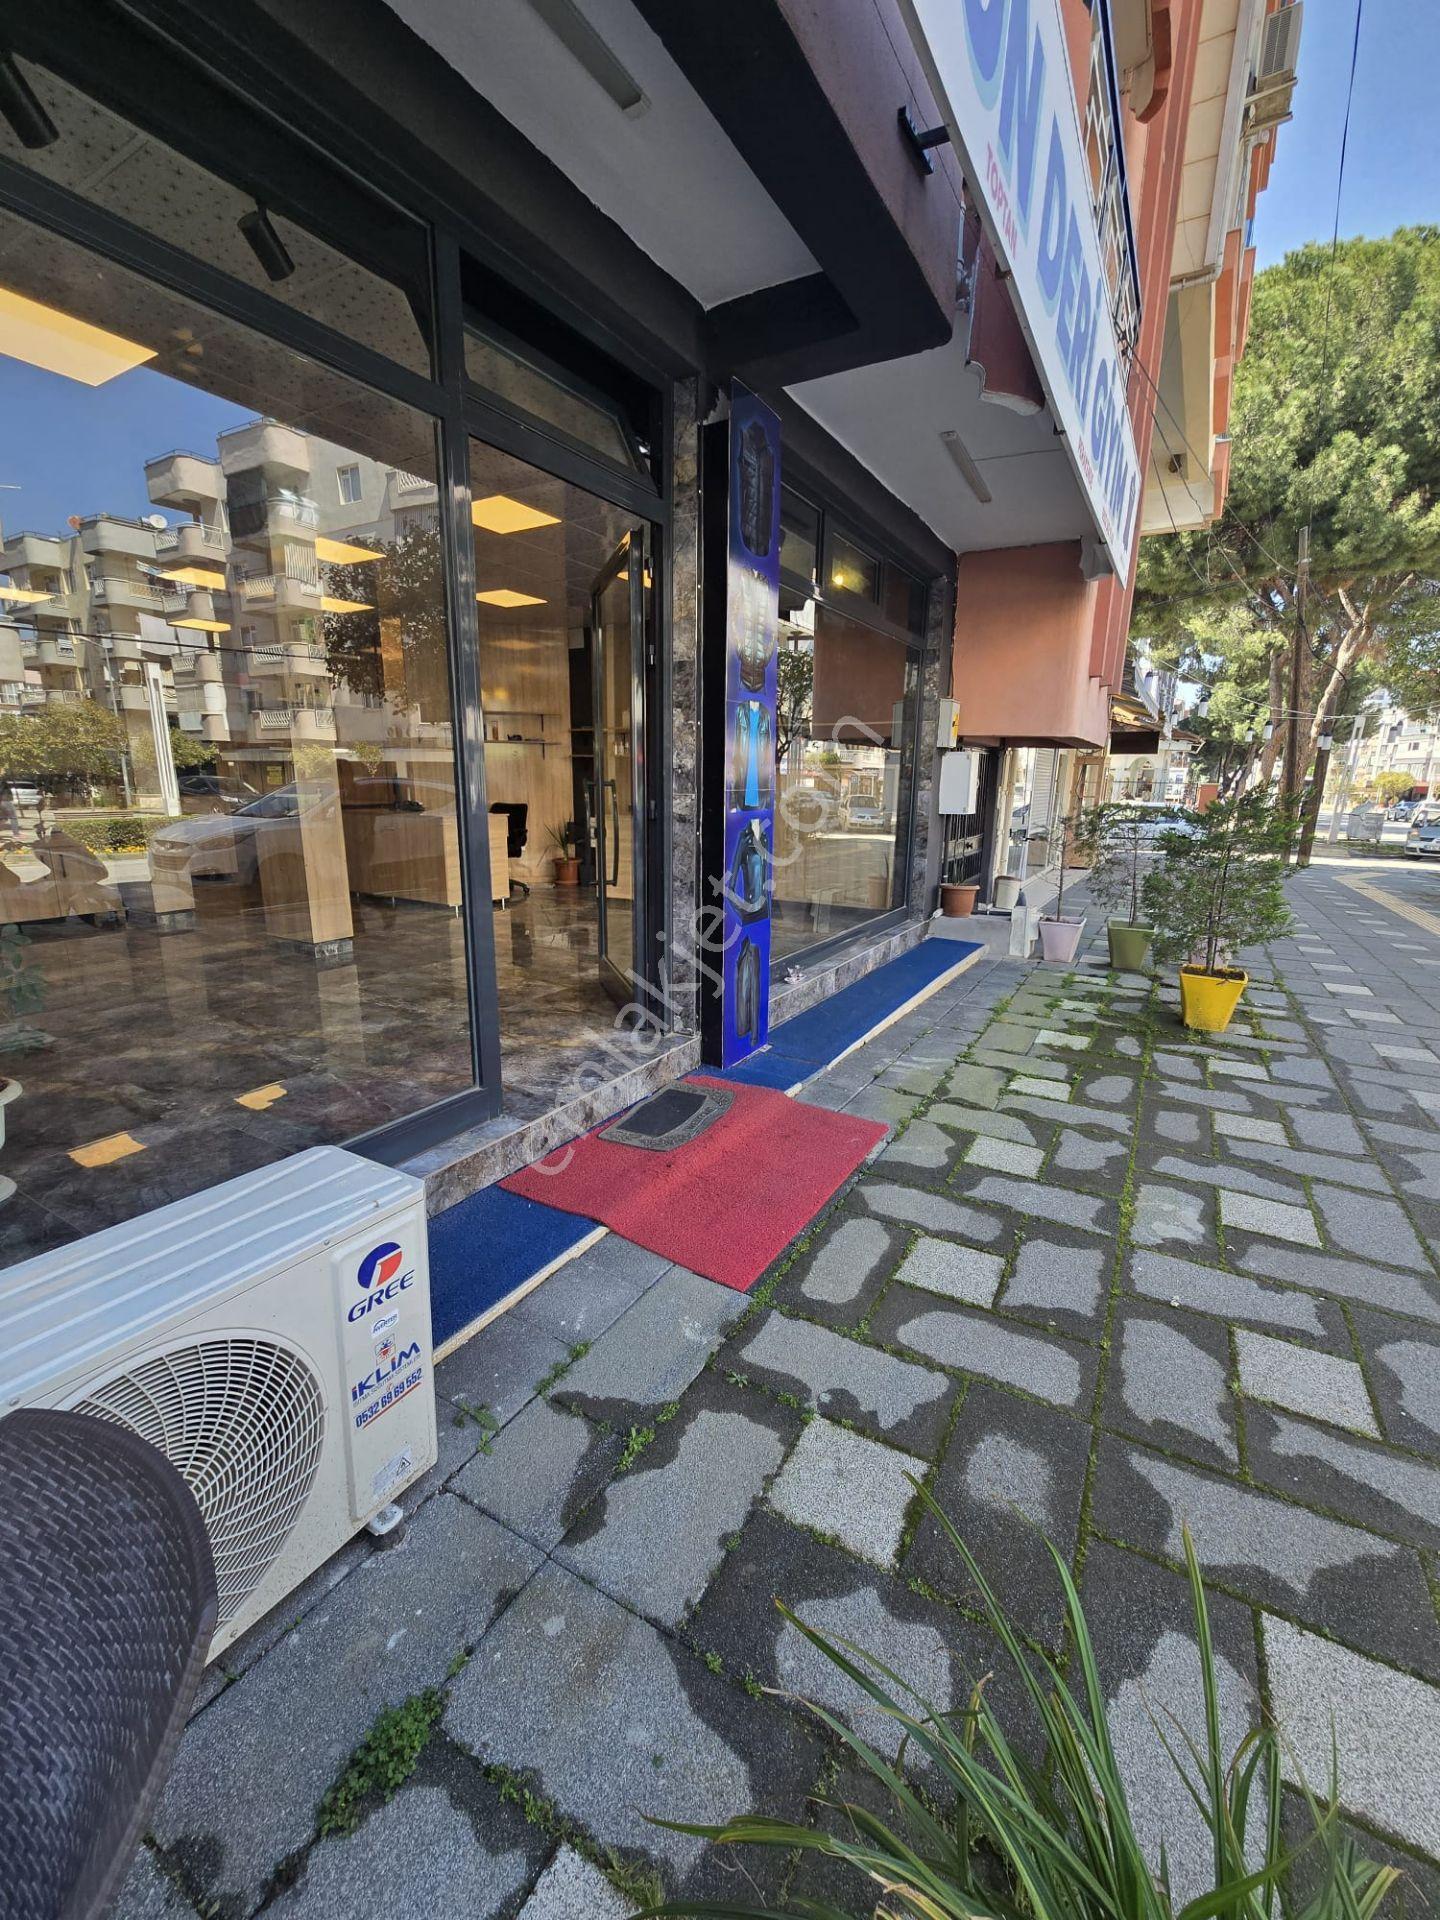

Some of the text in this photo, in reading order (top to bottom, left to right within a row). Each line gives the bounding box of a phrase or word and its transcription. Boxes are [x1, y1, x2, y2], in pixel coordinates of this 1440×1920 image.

[985, 143, 1018, 260] TOPTAN
[1036, 109, 1101, 430] DERİ
[1091, 358, 1129, 532] GİYİM
[347, 1269, 415, 1323] GREE
[355, 1401, 379, 1428] 0532
[405, 1367, 423, 1388] 552
